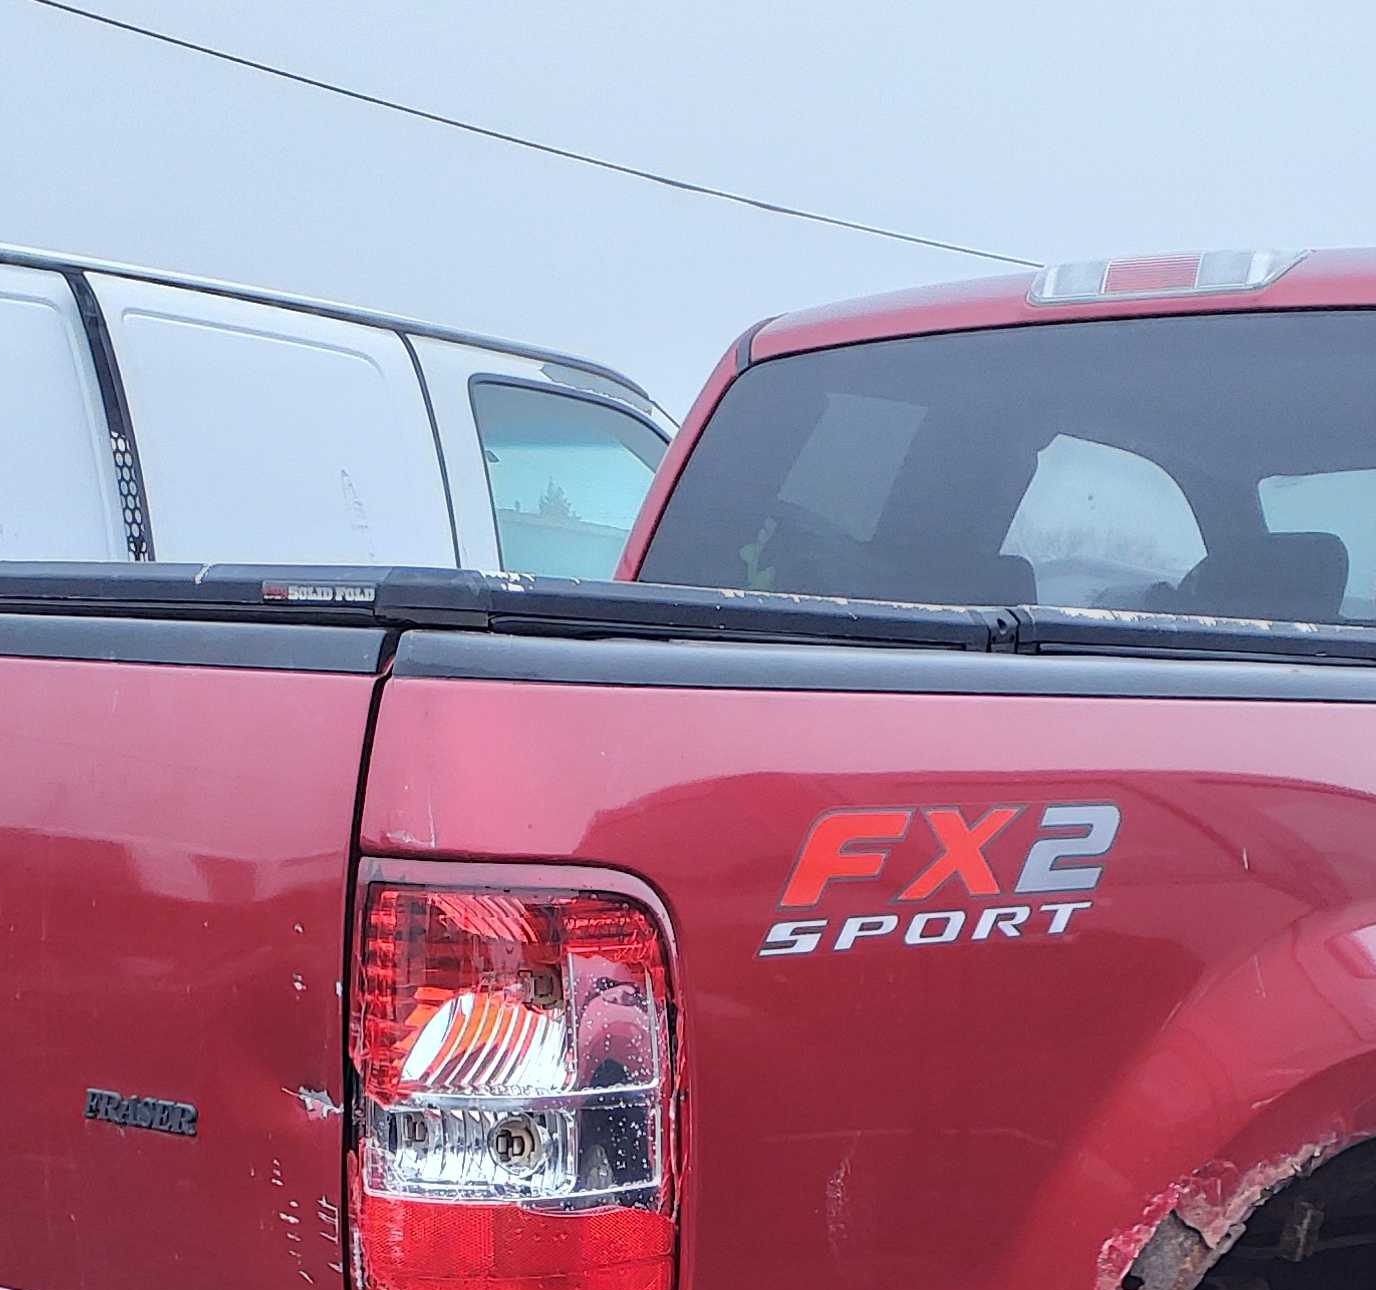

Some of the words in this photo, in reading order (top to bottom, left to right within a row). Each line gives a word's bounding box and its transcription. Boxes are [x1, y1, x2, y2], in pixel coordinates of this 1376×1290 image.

[287, 584, 334, 601] SOLID
[335, 586, 375, 601] FOLD
[776, 803, 1122, 909] FX2
[756, 901, 1094, 958] SPORT
